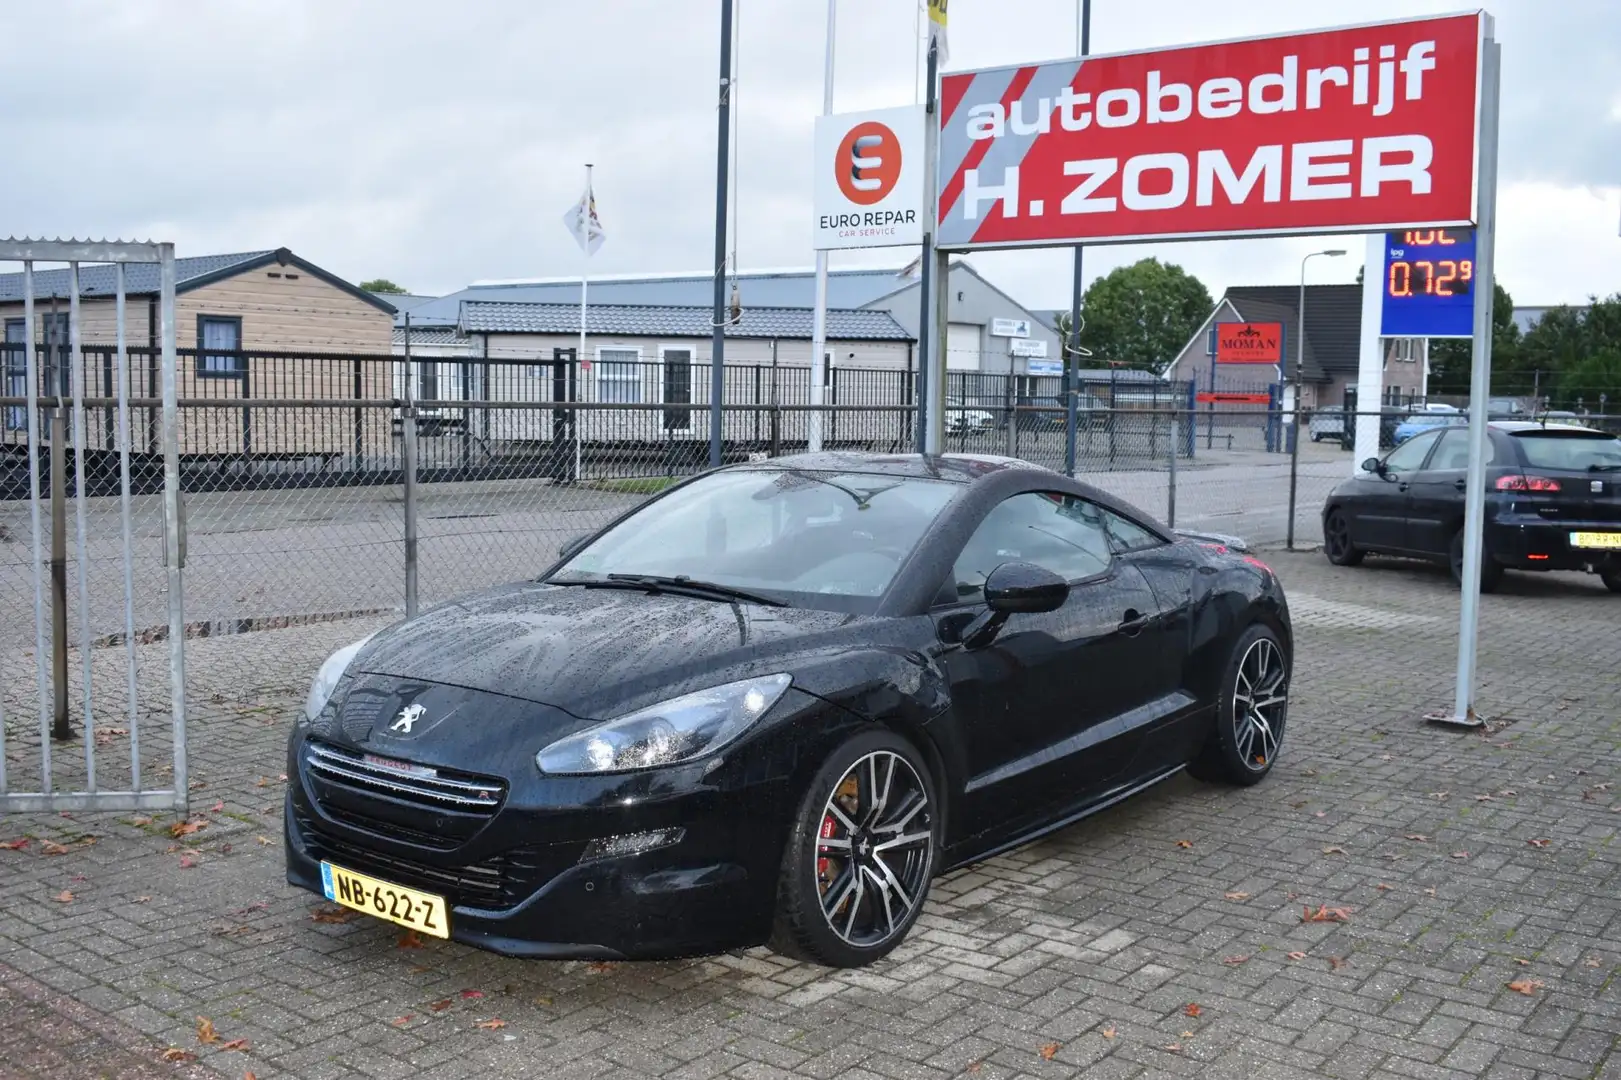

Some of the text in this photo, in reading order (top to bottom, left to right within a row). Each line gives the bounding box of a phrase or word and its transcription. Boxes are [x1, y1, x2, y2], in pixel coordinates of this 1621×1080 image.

[965, 40, 1436, 141] autobedrijf
[963, 133, 1435, 220] H. ZOMER
[820, 209, 916, 229] EURO REPAR
[838, 227, 895, 238] CAR SERVICE
[1390, 248, 1404, 257] lpg
[1222, 338, 1277, 350] MOMAN
[337, 872, 437, 929] NB-622-Z
